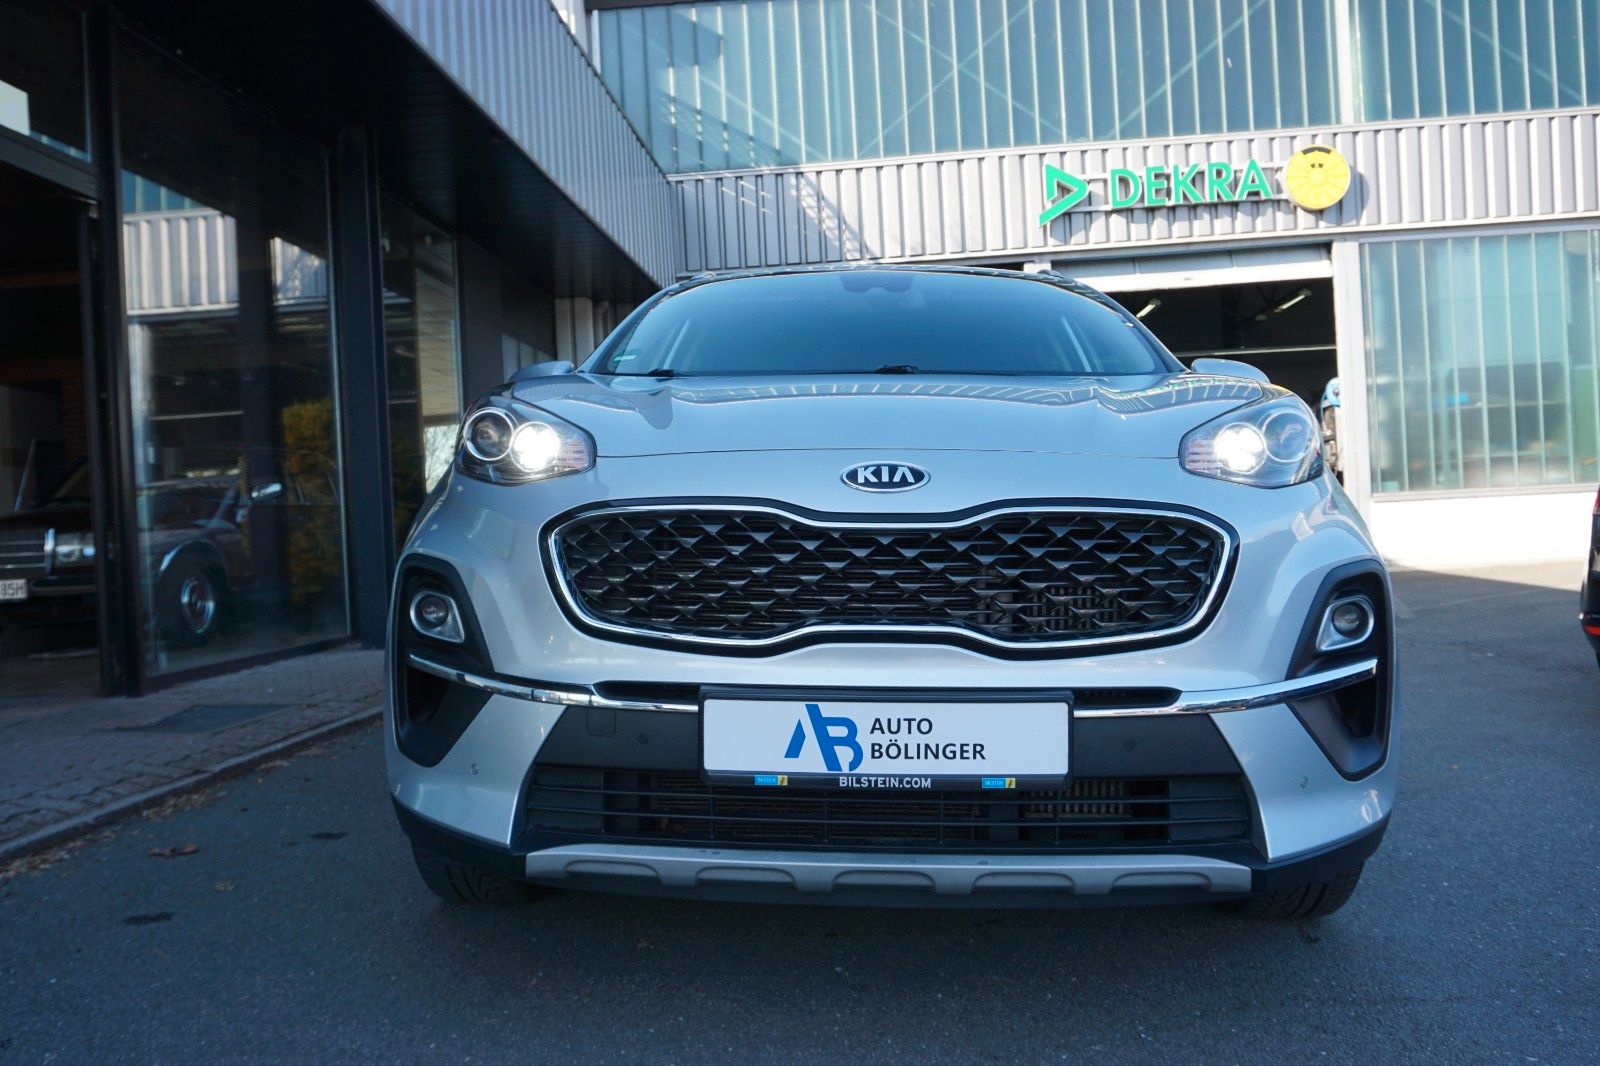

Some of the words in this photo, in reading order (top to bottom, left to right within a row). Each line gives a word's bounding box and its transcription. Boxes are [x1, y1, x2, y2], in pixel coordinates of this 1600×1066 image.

[1110, 159, 1273, 208] DEKRA
[857, 466, 915, 483] KIA
[870, 718, 933, 735] AUTO
[871, 739, 986, 760] BÖLINGER
[839, 776, 932, 788] BILSTEIN.COM
